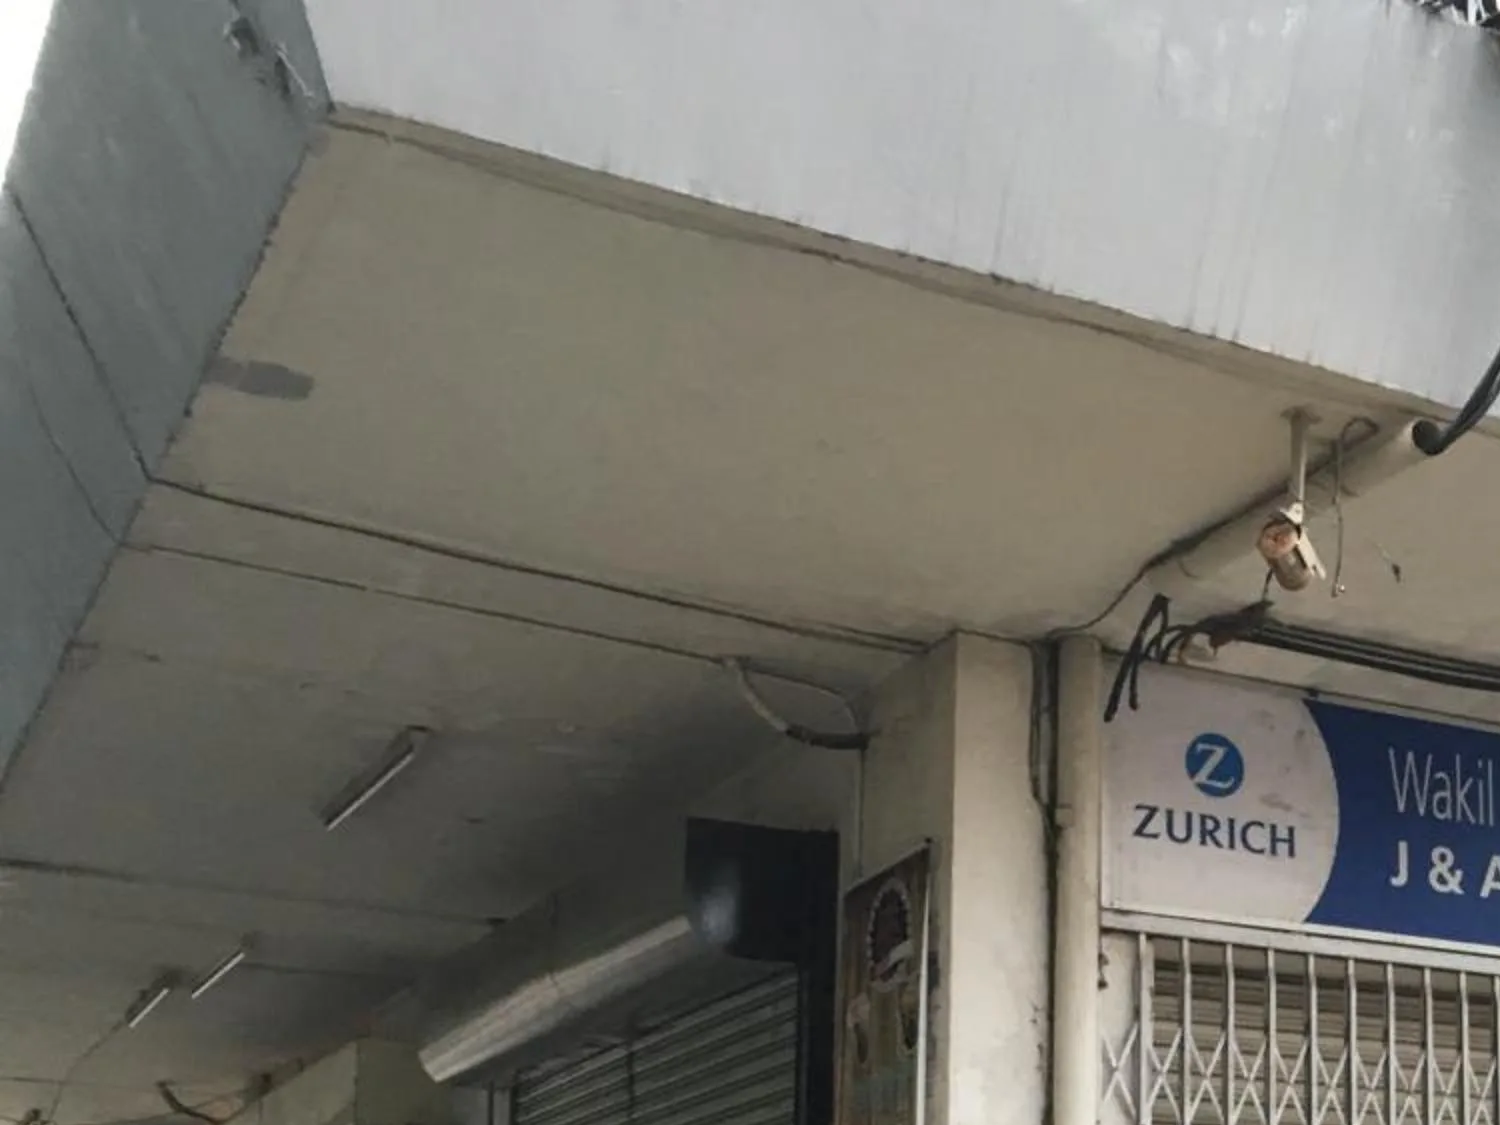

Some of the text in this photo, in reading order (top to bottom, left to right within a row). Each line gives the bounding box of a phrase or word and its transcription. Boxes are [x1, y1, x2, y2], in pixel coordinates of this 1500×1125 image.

[1389, 747, 1495, 828] Wakil
[1132, 803, 1296, 859] ZURICH
[1390, 840, 1409, 887] J
[1428, 845, 1465, 895] &
